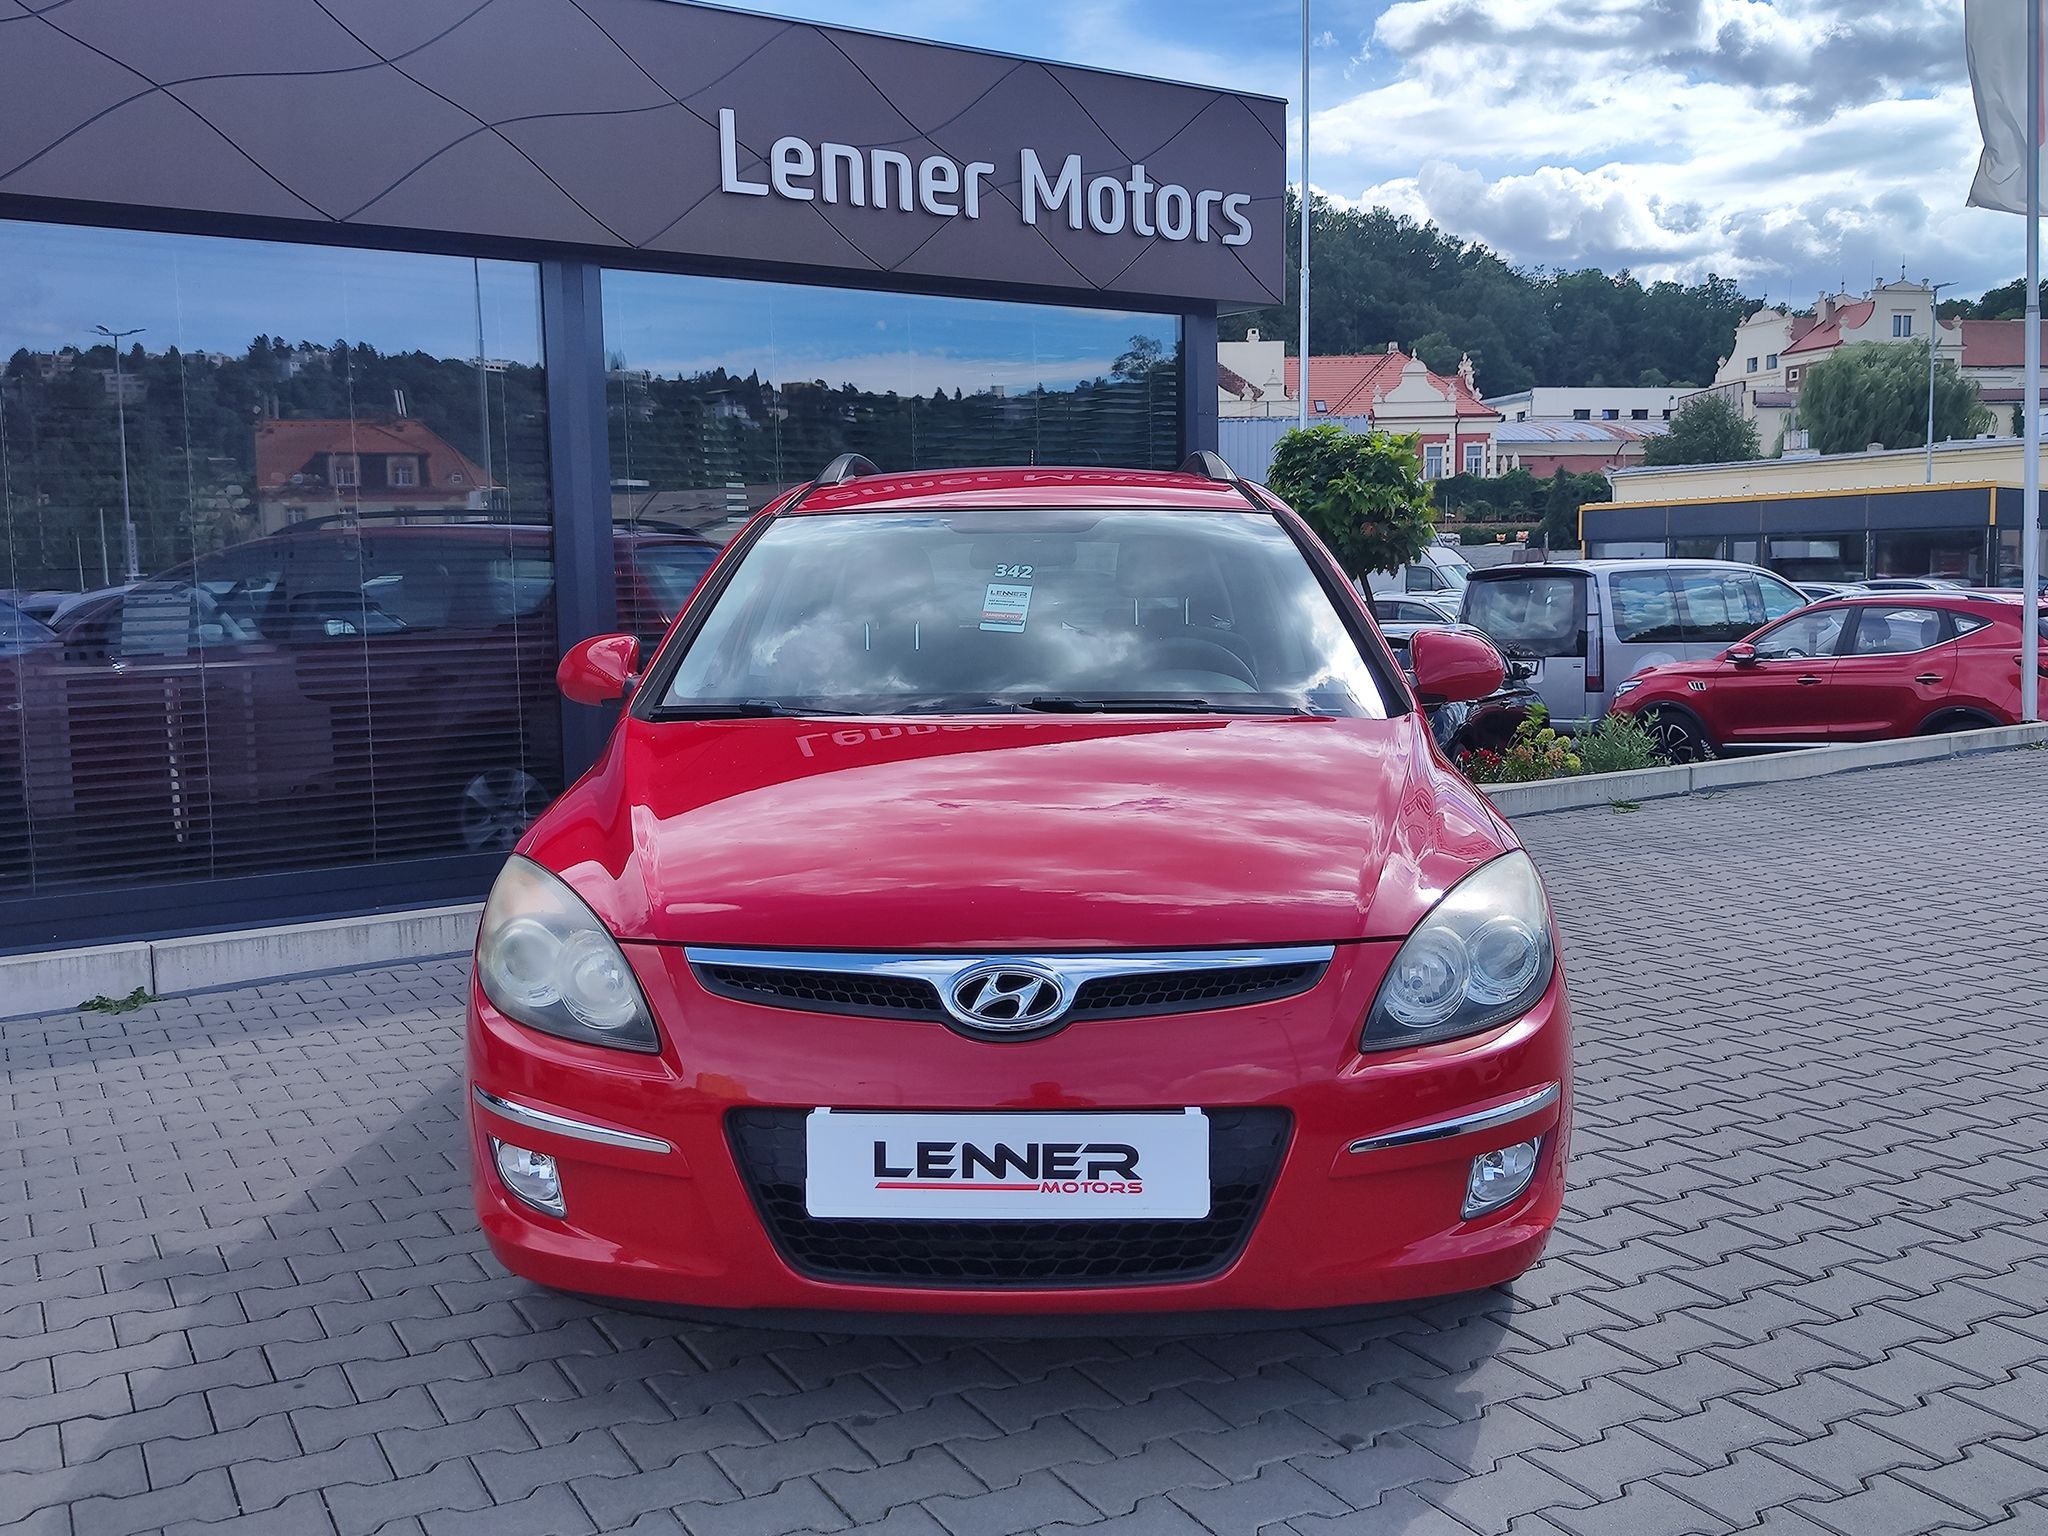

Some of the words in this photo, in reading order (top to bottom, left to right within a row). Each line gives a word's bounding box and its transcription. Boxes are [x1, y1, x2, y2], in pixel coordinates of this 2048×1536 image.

[719, 108, 995, 219] Lenner
[1020, 148, 1252, 246] Motors
[994, 563, 1033, 579] 342
[874, 1140, 1143, 1180] LENNER
[1040, 1181, 1143, 1194] MOTORS
